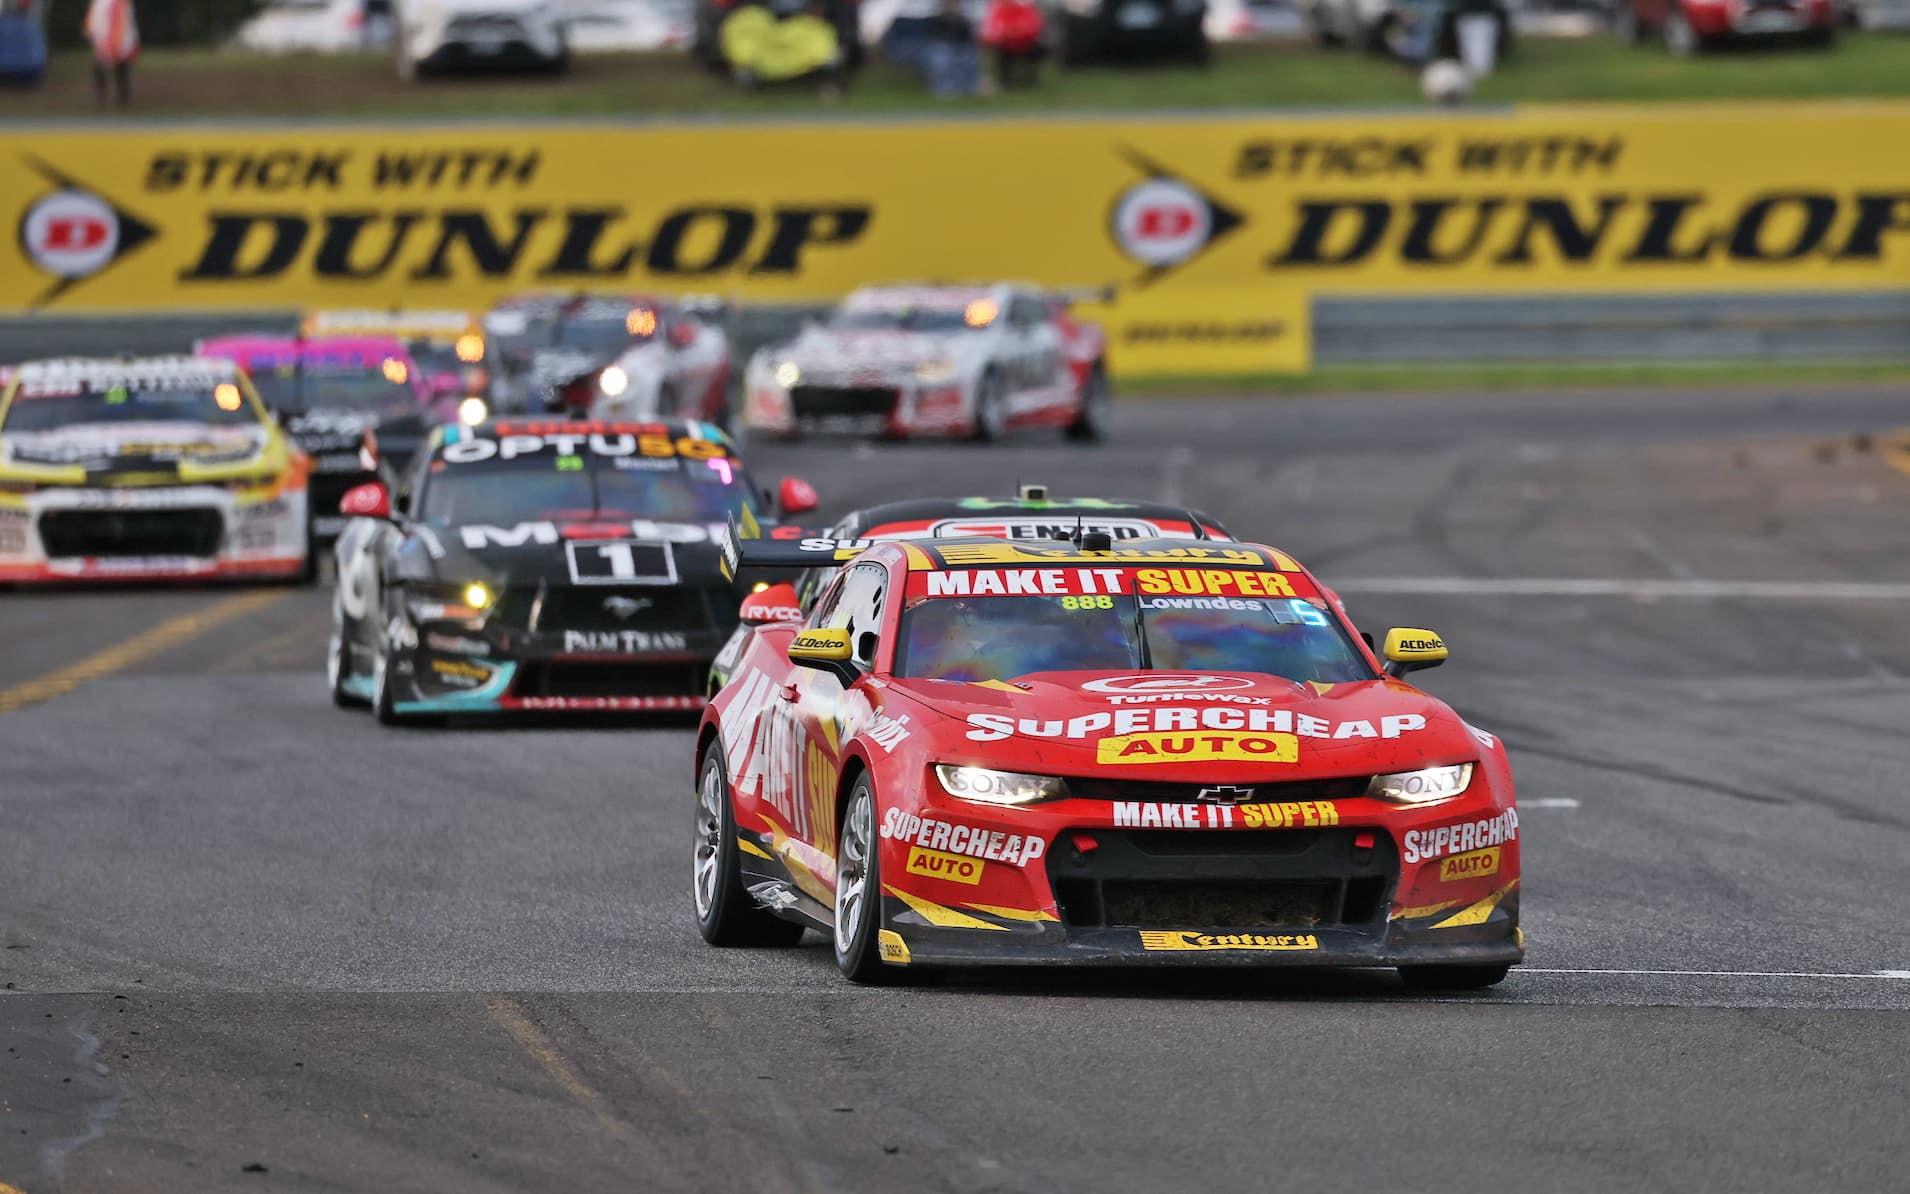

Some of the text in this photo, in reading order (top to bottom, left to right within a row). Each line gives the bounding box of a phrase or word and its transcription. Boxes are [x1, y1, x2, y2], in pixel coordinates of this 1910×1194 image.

[145, 150, 541, 190] STICK WITH
[1237, 136, 1624, 176] STICK WITH
[43, 217, 108, 251] D
[178, 206, 872, 281] DUNLOP
[598, 543, 637, 580] 1
[927, 569, 1297, 597] MAKE IT SUPER
[1062, 595, 1114, 610] 888
[1138, 595, 1263, 611] Lowndes
[965, 707, 1427, 741] SUPERCHEAP
[1118, 737, 1277, 757] AUTO
[949, 771, 1052, 799] SONY
[1392, 770, 1466, 796] SONY
[1112, 801, 1340, 828] MAKE IT SUPER
[880, 806, 1046, 868] SUPERCHEAP
[1403, 806, 1520, 864] SUPERCHEAP
[912, 854, 975, 877] AUTO
[1446, 854, 1493, 875] AUTO
